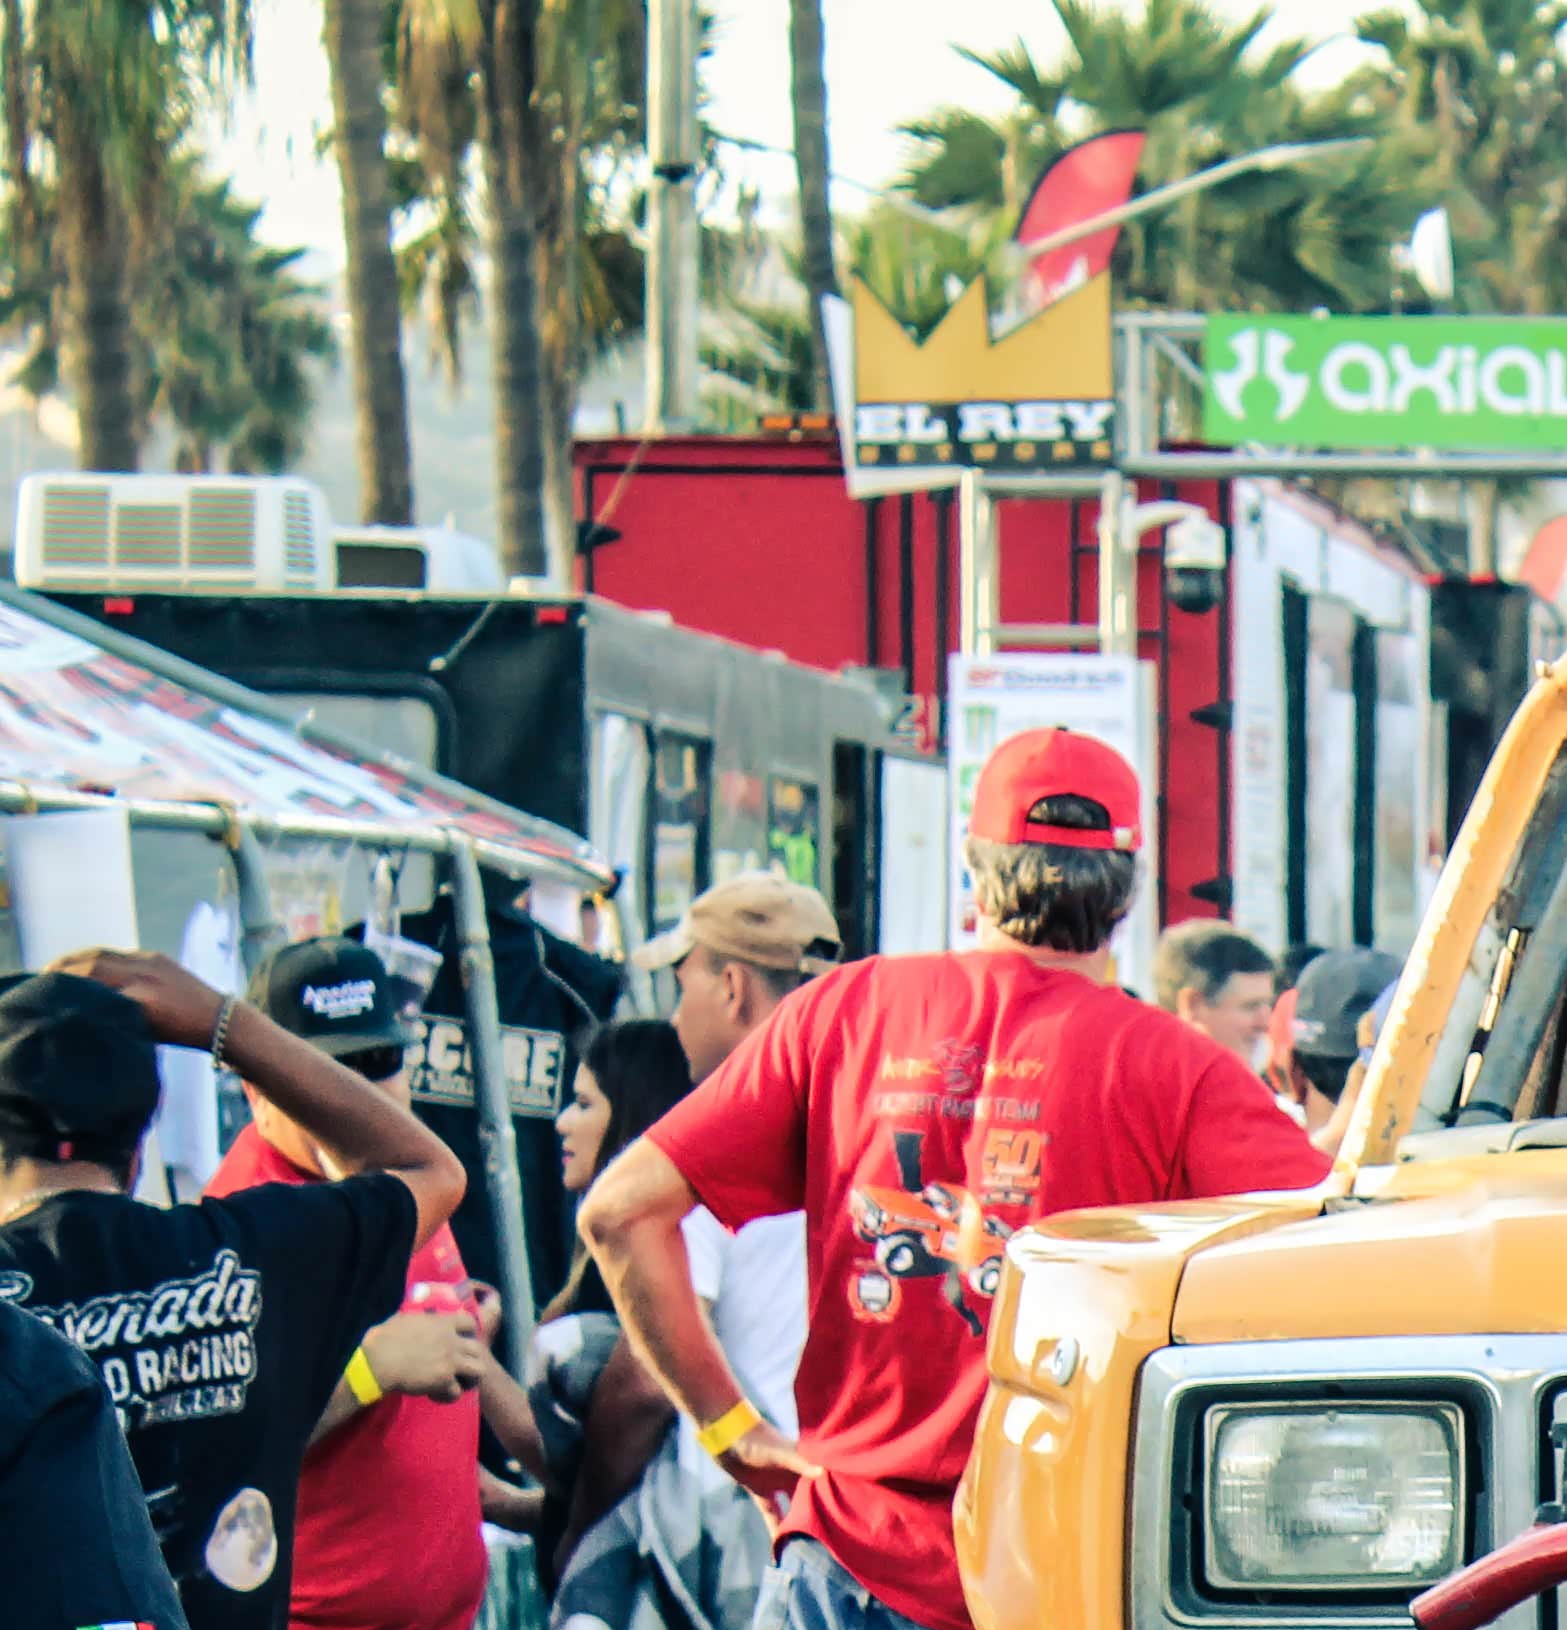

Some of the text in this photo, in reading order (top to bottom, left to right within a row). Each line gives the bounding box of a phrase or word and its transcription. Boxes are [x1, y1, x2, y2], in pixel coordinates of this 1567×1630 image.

[856, 401, 1116, 443] EL REY
[404, 1019, 558, 1088] SCRE
